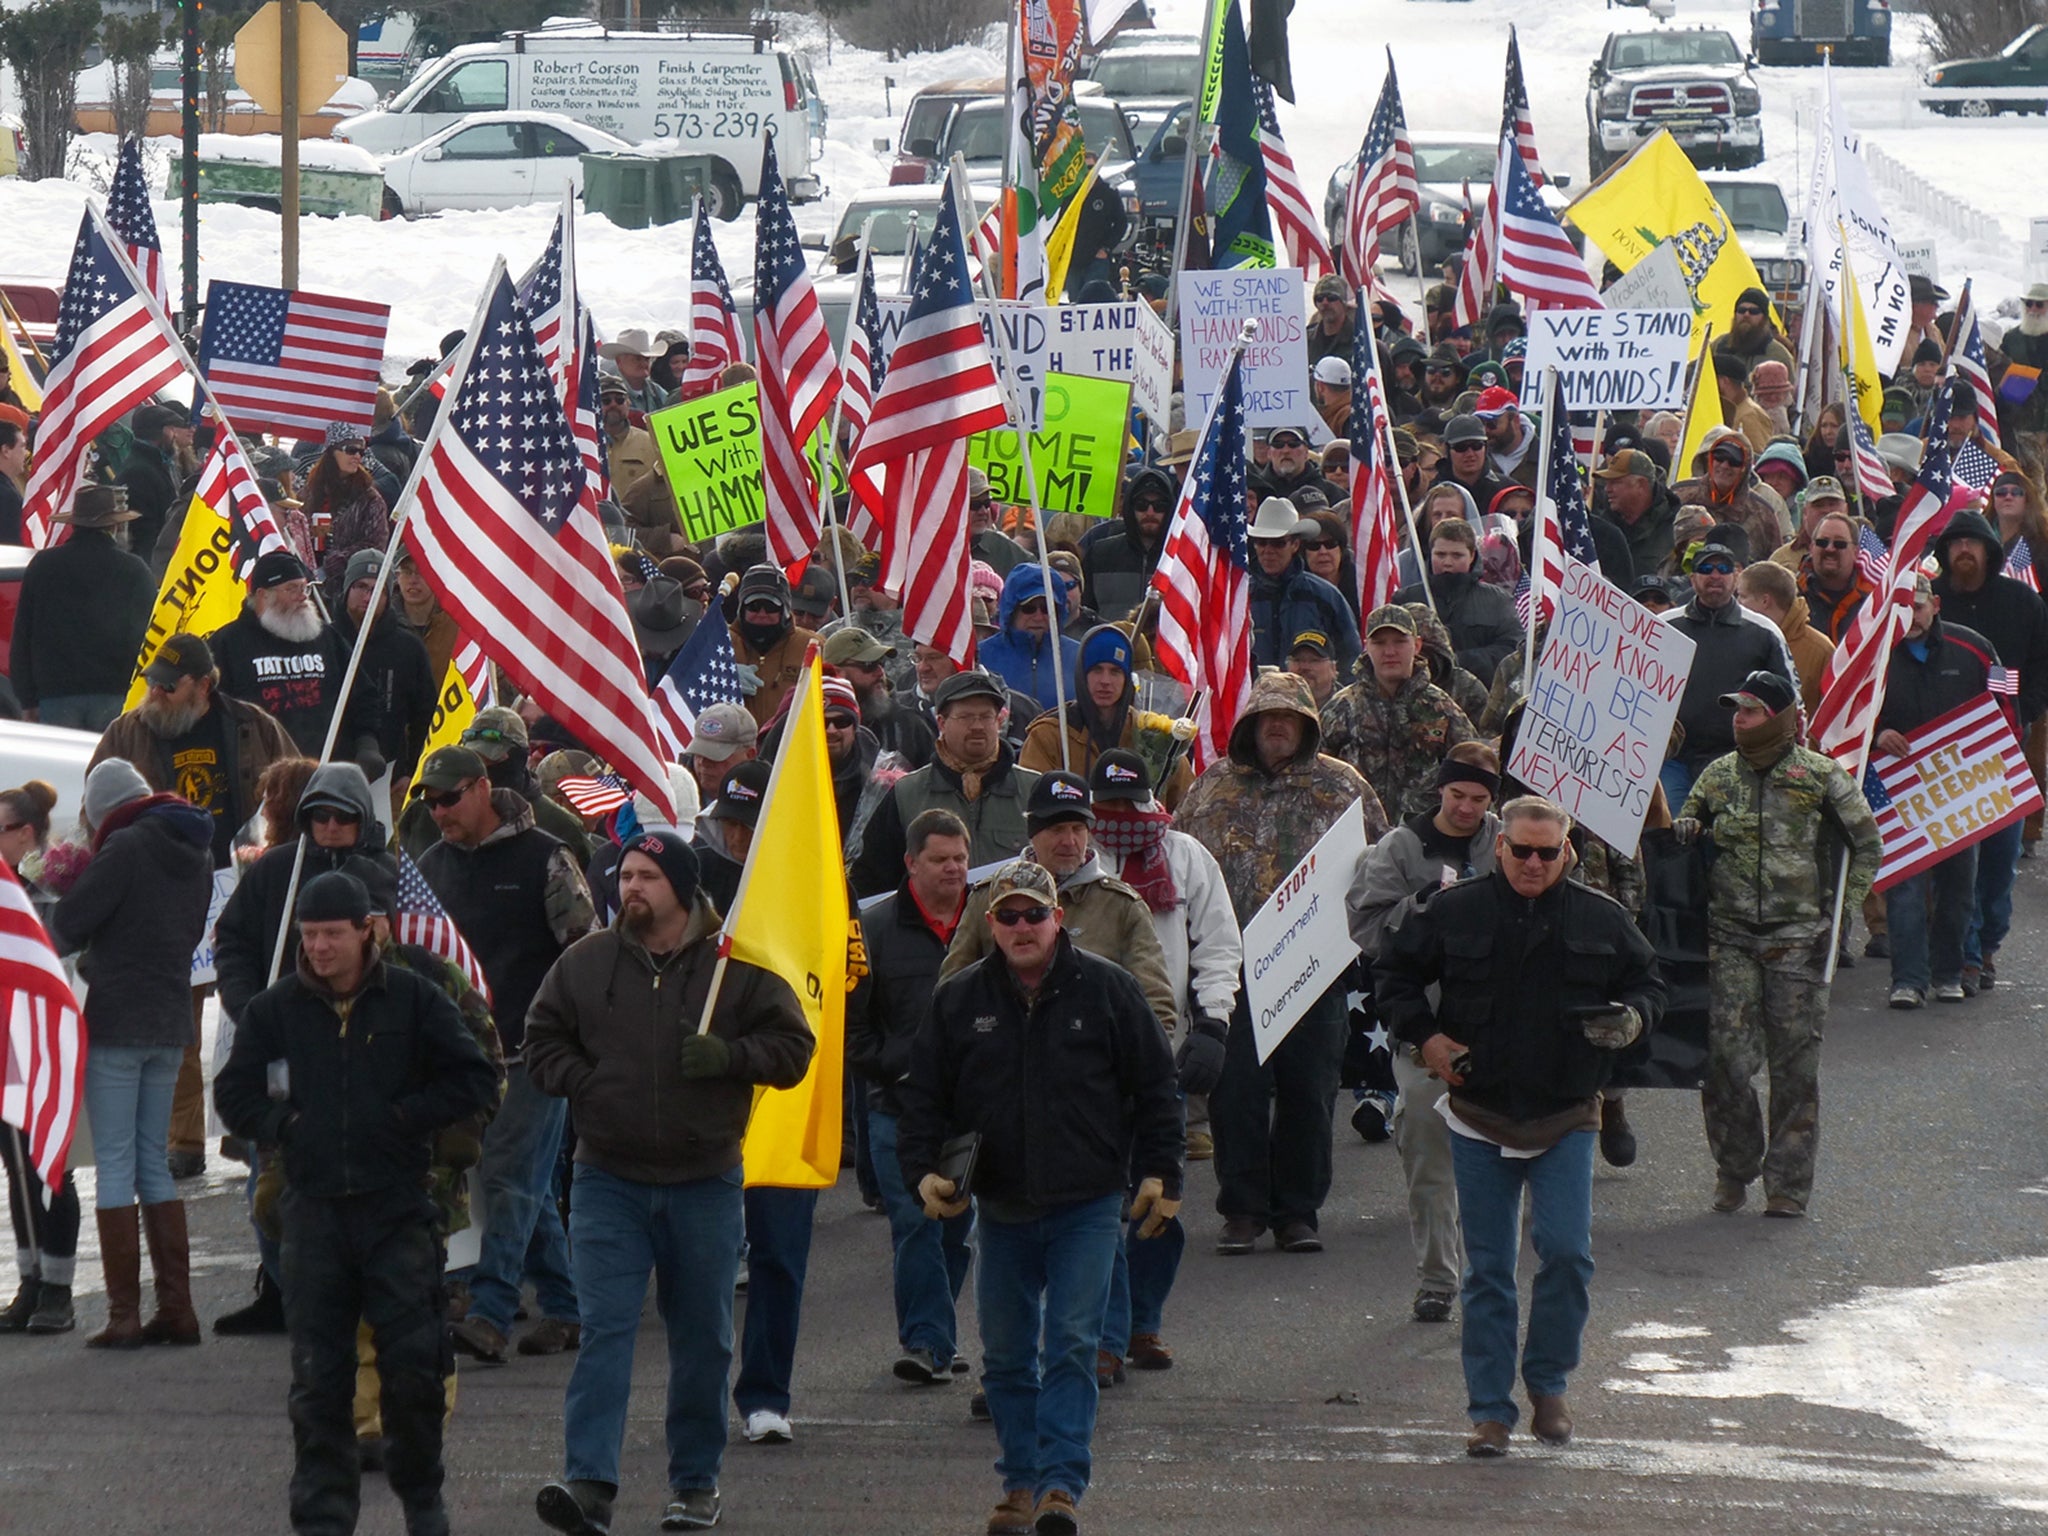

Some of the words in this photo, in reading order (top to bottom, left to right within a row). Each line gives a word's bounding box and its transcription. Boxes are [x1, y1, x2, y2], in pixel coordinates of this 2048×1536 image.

[533, 59, 583, 74] Robert
[588, 60, 640, 74] Corson
[658, 60, 695, 74] Finish
[702, 62, 762, 77] Carpenter
[691, 76, 718, 85] Block
[531, 88, 566, 96] Custom
[657, 100, 678, 109] and
[684, 100, 710, 110] Much
[654, 112, 779, 138] 573-2396
[1611, 229, 1646, 259] DONT
[1194, 280, 1222, 297] WE
[1232, 277, 1290, 297] STAND
[1061, 308, 1136, 333] STAND
[1248, 298, 1282, 313] THE
[1191, 315, 1301, 345] HAMONDS
[1544, 315, 1602, 337] WE
[1612, 312, 1692, 338] STAND
[1093, 348, 1133, 372] THE
[667, 410, 724, 454] WE
[968, 431, 1096, 472] HOME
[987, 462, 1092, 513] BLM!
[1564, 561, 1665, 651] SOMEONE
[252, 653, 326, 676] TATTOOS
[1559, 594, 1610, 656] YOU
[1613, 634, 1686, 702] KNOW
[1539, 638, 1600, 694] MAY
[1608, 676, 1658, 737] BE
[1532, 671, 1597, 743] HELD
[1603, 731, 1649, 779] AS
[1526, 706, 1650, 818] TERRORISTS
[1914, 742, 1963, 785] LET
[1894, 752, 2008, 831] FREEDOM
[1925, 784, 2016, 851] REIGN
[1276, 853, 1317, 913] STOP!
[1253, 892, 1320, 981] Government
[1260, 954, 1321, 1030] Overreach
